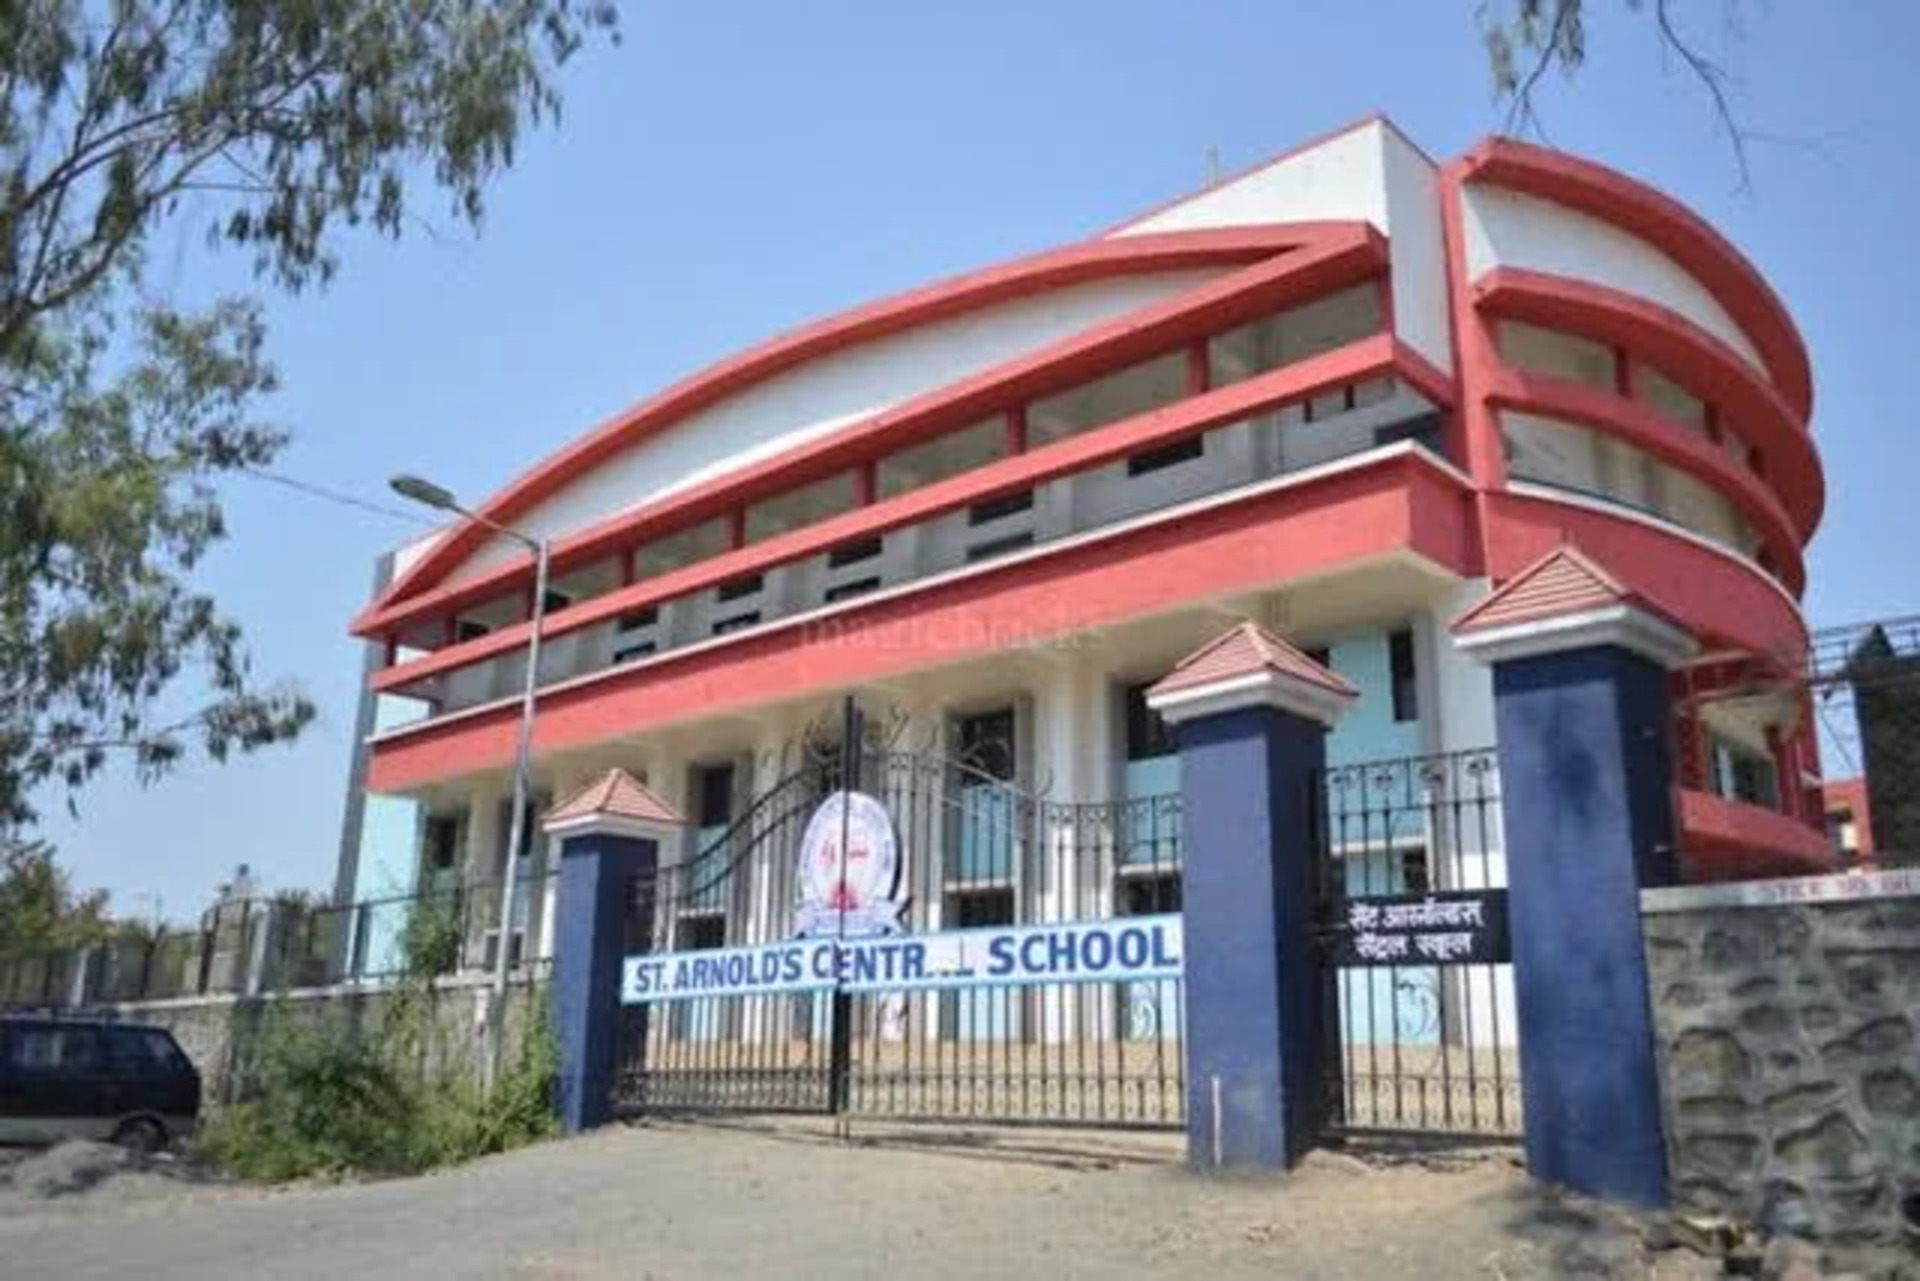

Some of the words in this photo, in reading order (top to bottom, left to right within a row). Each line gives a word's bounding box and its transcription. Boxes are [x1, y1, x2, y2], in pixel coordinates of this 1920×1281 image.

[635, 961, 668, 994] ST.
[674, 946, 803, 990] ARNOLD'S
[813, 940, 975, 983] CENTRL
[987, 925, 1181, 976] SCHOOL
